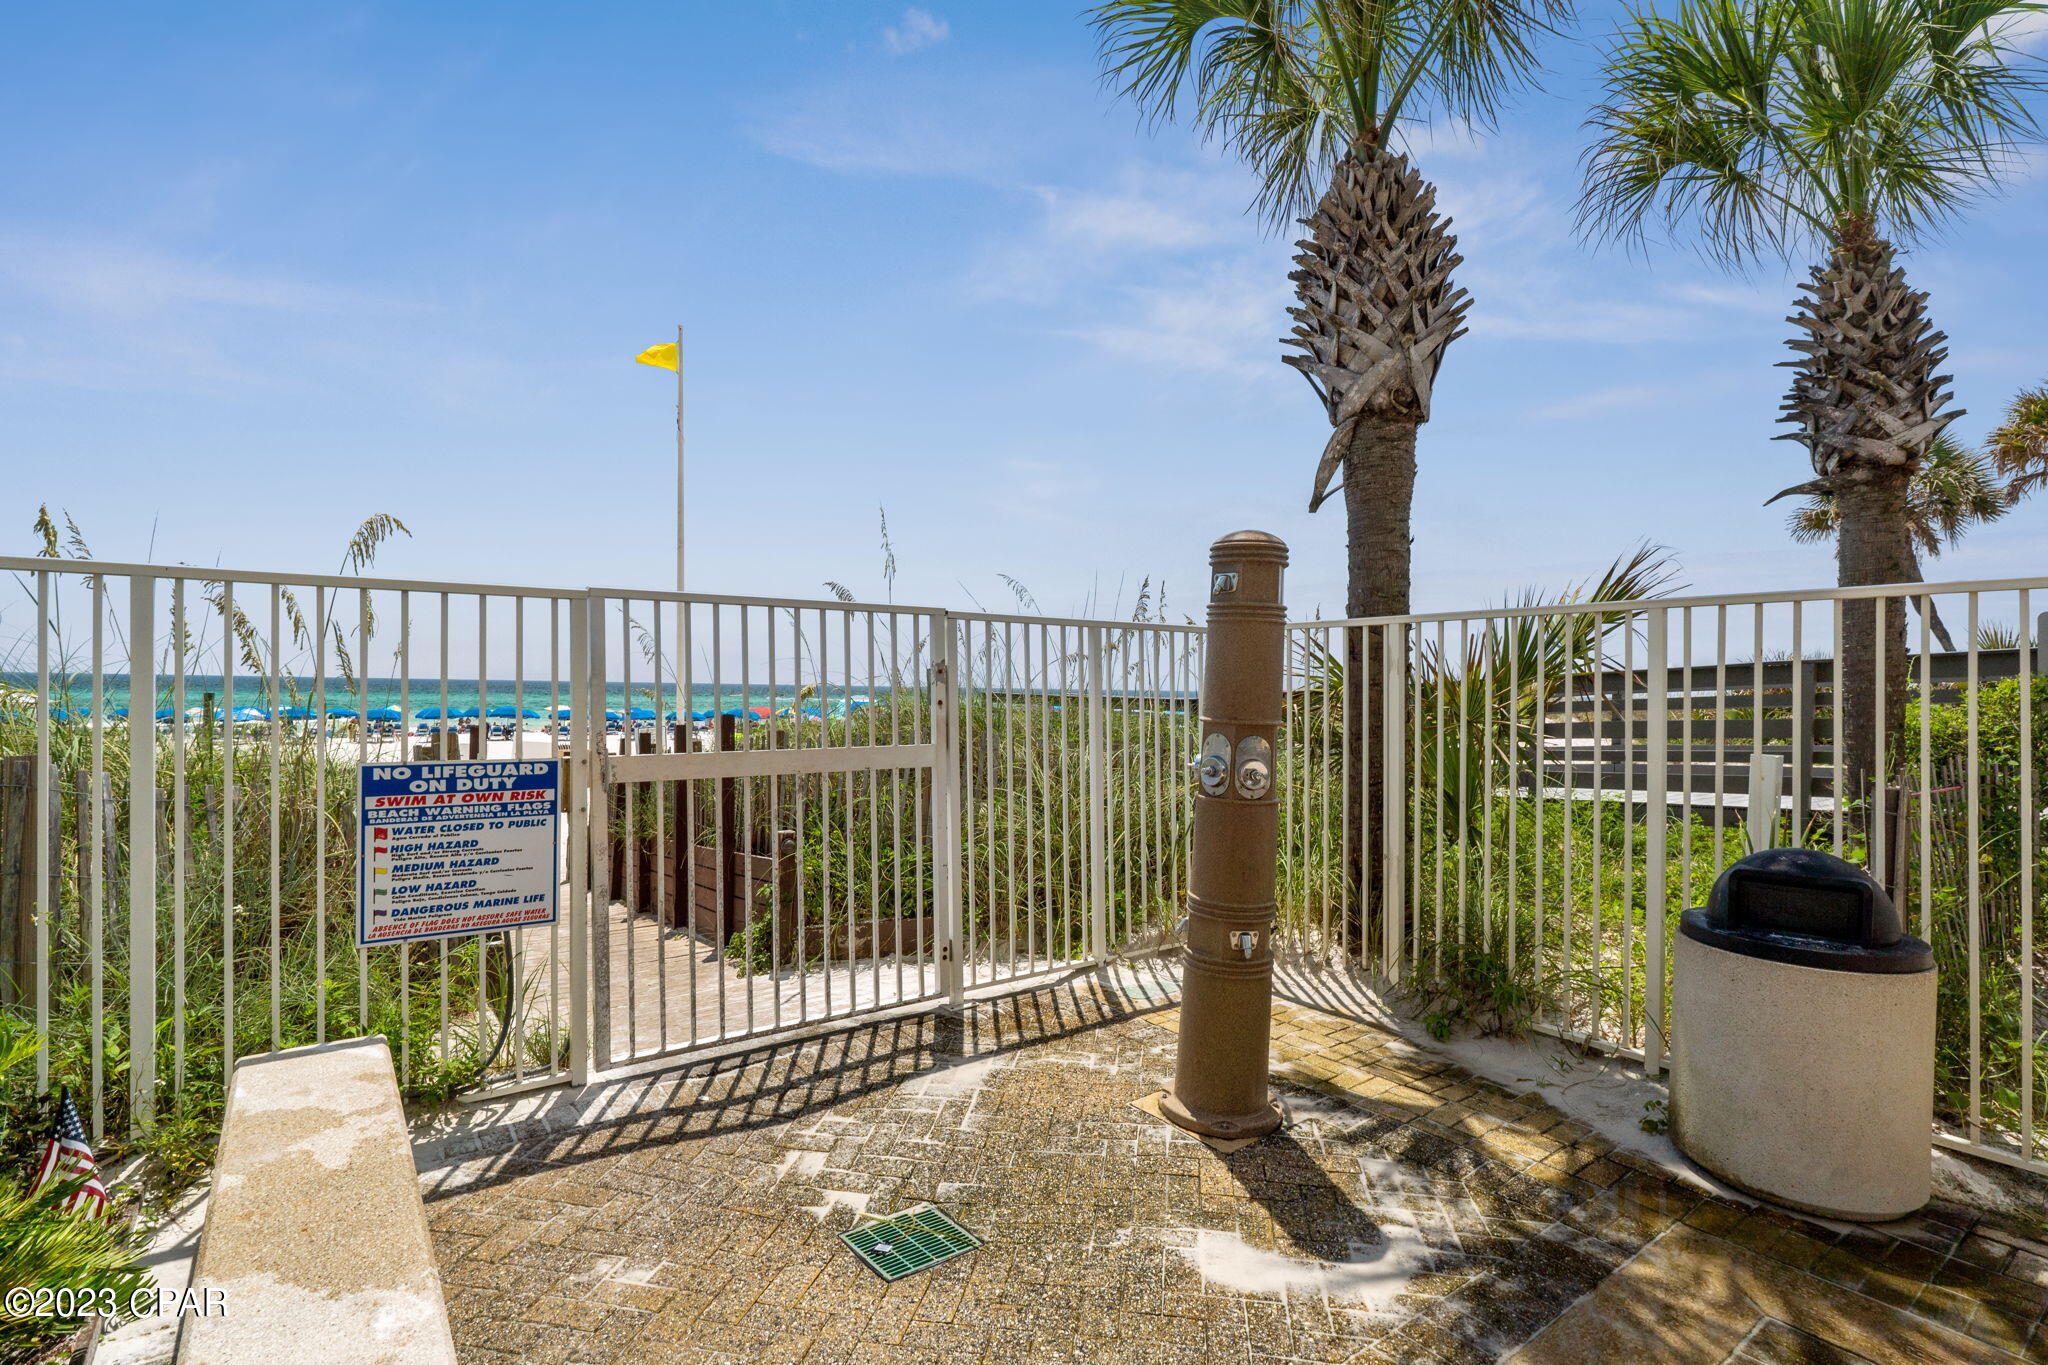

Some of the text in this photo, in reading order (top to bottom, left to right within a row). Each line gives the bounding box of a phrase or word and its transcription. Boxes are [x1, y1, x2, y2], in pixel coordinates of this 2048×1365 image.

[373, 763, 549, 780] NO LIFEGUARD
[409, 777, 517, 793] ON DUTY
[374, 790, 546, 807] SWIM AT OWN RISK
[367, 801, 551, 819] BEACH WARNING FLAGS
[391, 818, 547, 836] WATER CLOSED TO PUBLIC
[390, 840, 479, 853] HIGH HAZARD
[391, 857, 499, 873] MEDIUM HAZARD
[391, 880, 477, 895] LOW HAZARD
[391, 893, 545, 917] DANGEROUS MARINE LIFE
[373, 923, 407, 933] ABSENCE
[421, 919, 438, 927] FLAG
[441, 917, 460, 925] DOES
[462, 915, 476, 923] NOT
[477, 913, 504, 921] ASSURE
[505, 910, 523, 918] SAFE
[377, 928, 411, 938] AUSENCIA
[424, 924, 459, 933] BANDERAS
[523, 914, 550, 922] SEGURAS
